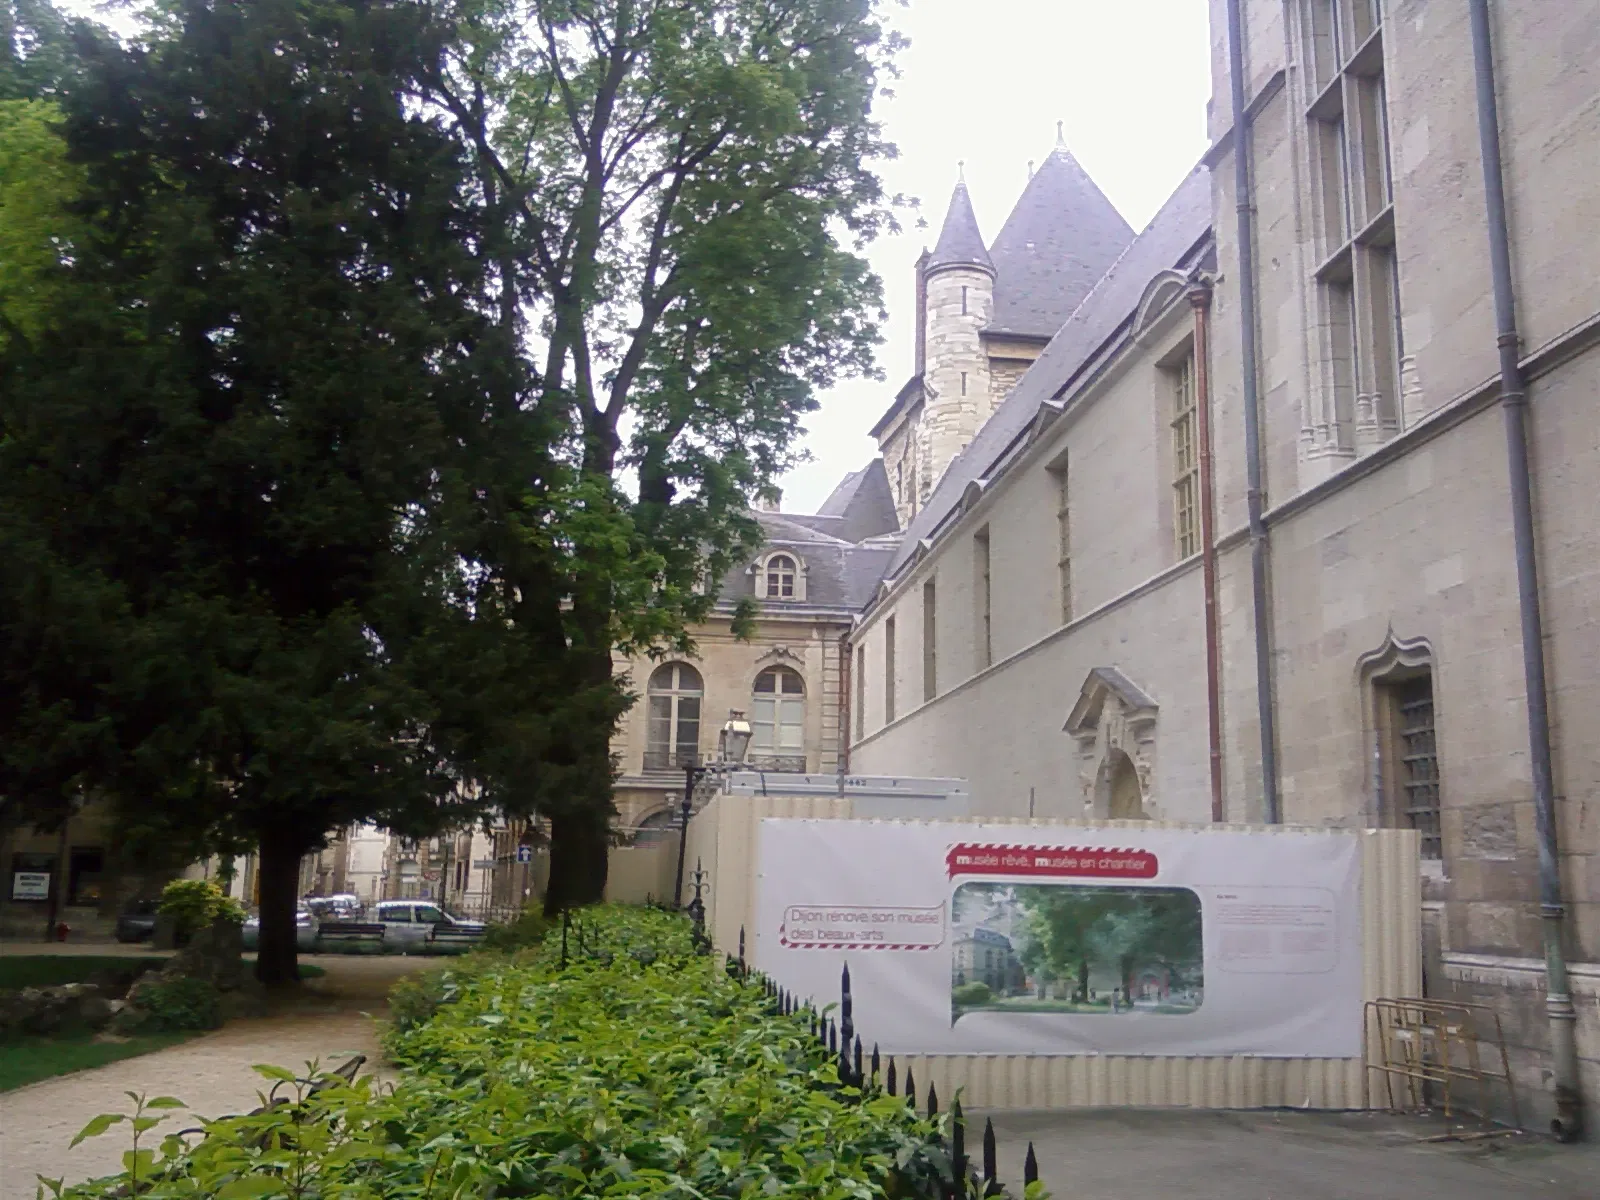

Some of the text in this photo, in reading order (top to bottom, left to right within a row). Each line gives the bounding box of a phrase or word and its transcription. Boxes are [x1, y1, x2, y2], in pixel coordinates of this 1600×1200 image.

[956, 854, 998, 866] musée
[1035, 855, 1077, 868] musée
[1080, 858, 1095, 868] en
[1099, 857, 1146, 869] chantier
[791, 909, 822, 923] Dijon
[872, 913, 894, 923] son
[898, 912, 939, 924] musée
[791, 929, 883, 940] des beaux-arts
